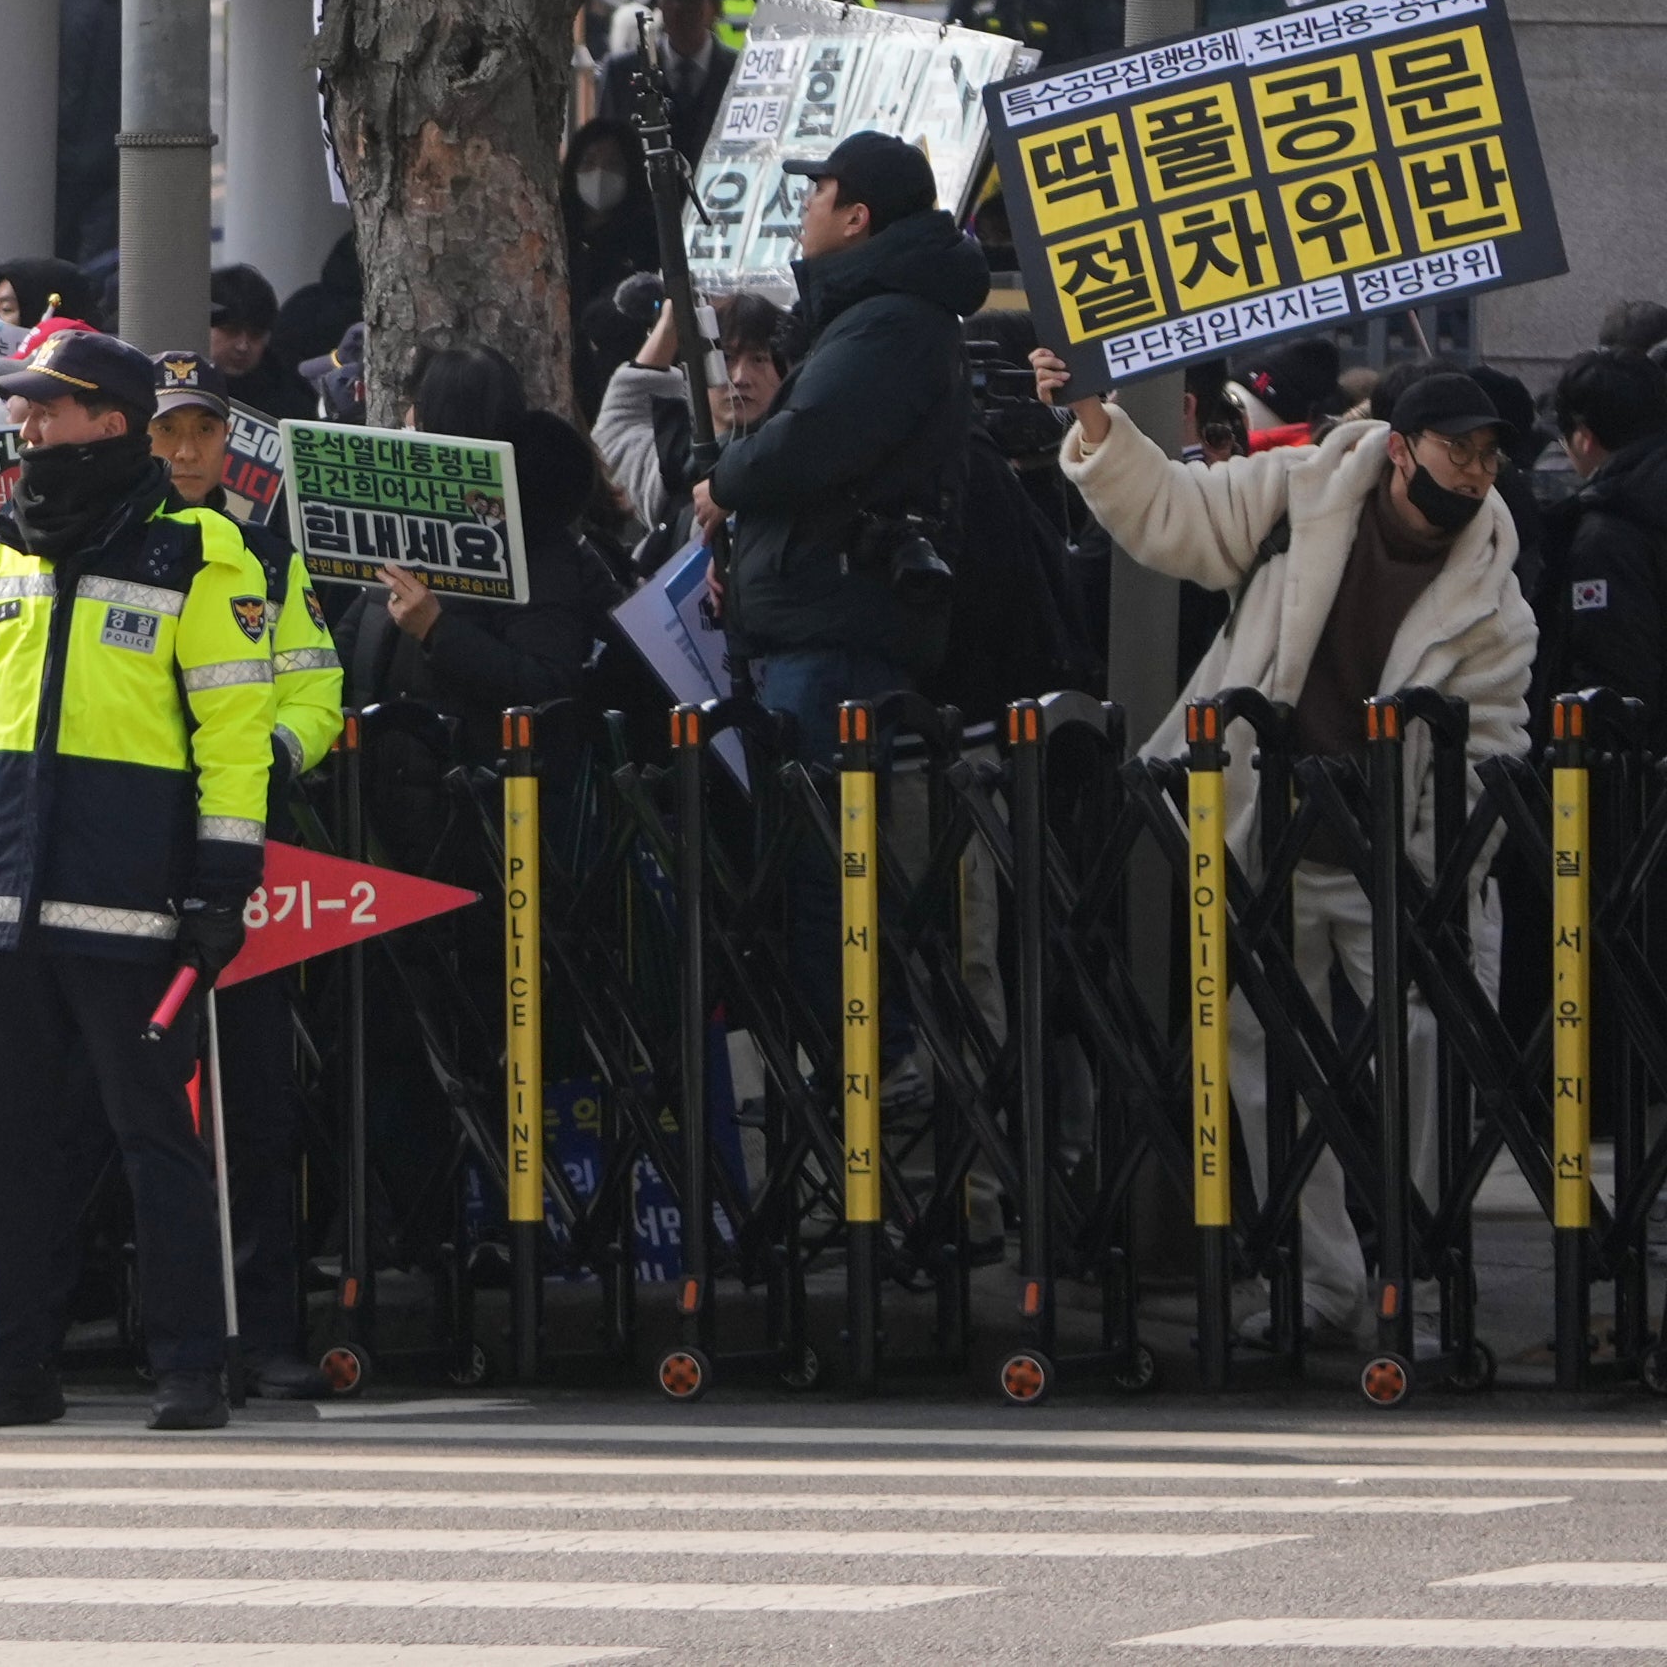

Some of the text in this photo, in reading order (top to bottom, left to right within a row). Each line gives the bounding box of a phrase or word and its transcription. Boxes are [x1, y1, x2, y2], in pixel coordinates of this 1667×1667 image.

[1007, 31, 1240, 117] 특수공무집행방해
[1029, 37, 1484, 210] 딱풀공문
[1059, 142, 1508, 334] 절차위반
[1107, 243, 1497, 372] 무단침입저지는 정당방위
[293, 427, 494, 482] 윤석열대통령님
[296, 463, 467, 515] 김건희여사님
[301, 500, 509, 579] 힘내세요
[433, 573, 511, 596] 싸우겠습니다
[105, 630, 150, 649] POLICE
[508, 858, 529, 1174] POLICE LINE
[1194, 853, 1217, 1177] POLICE LINE
